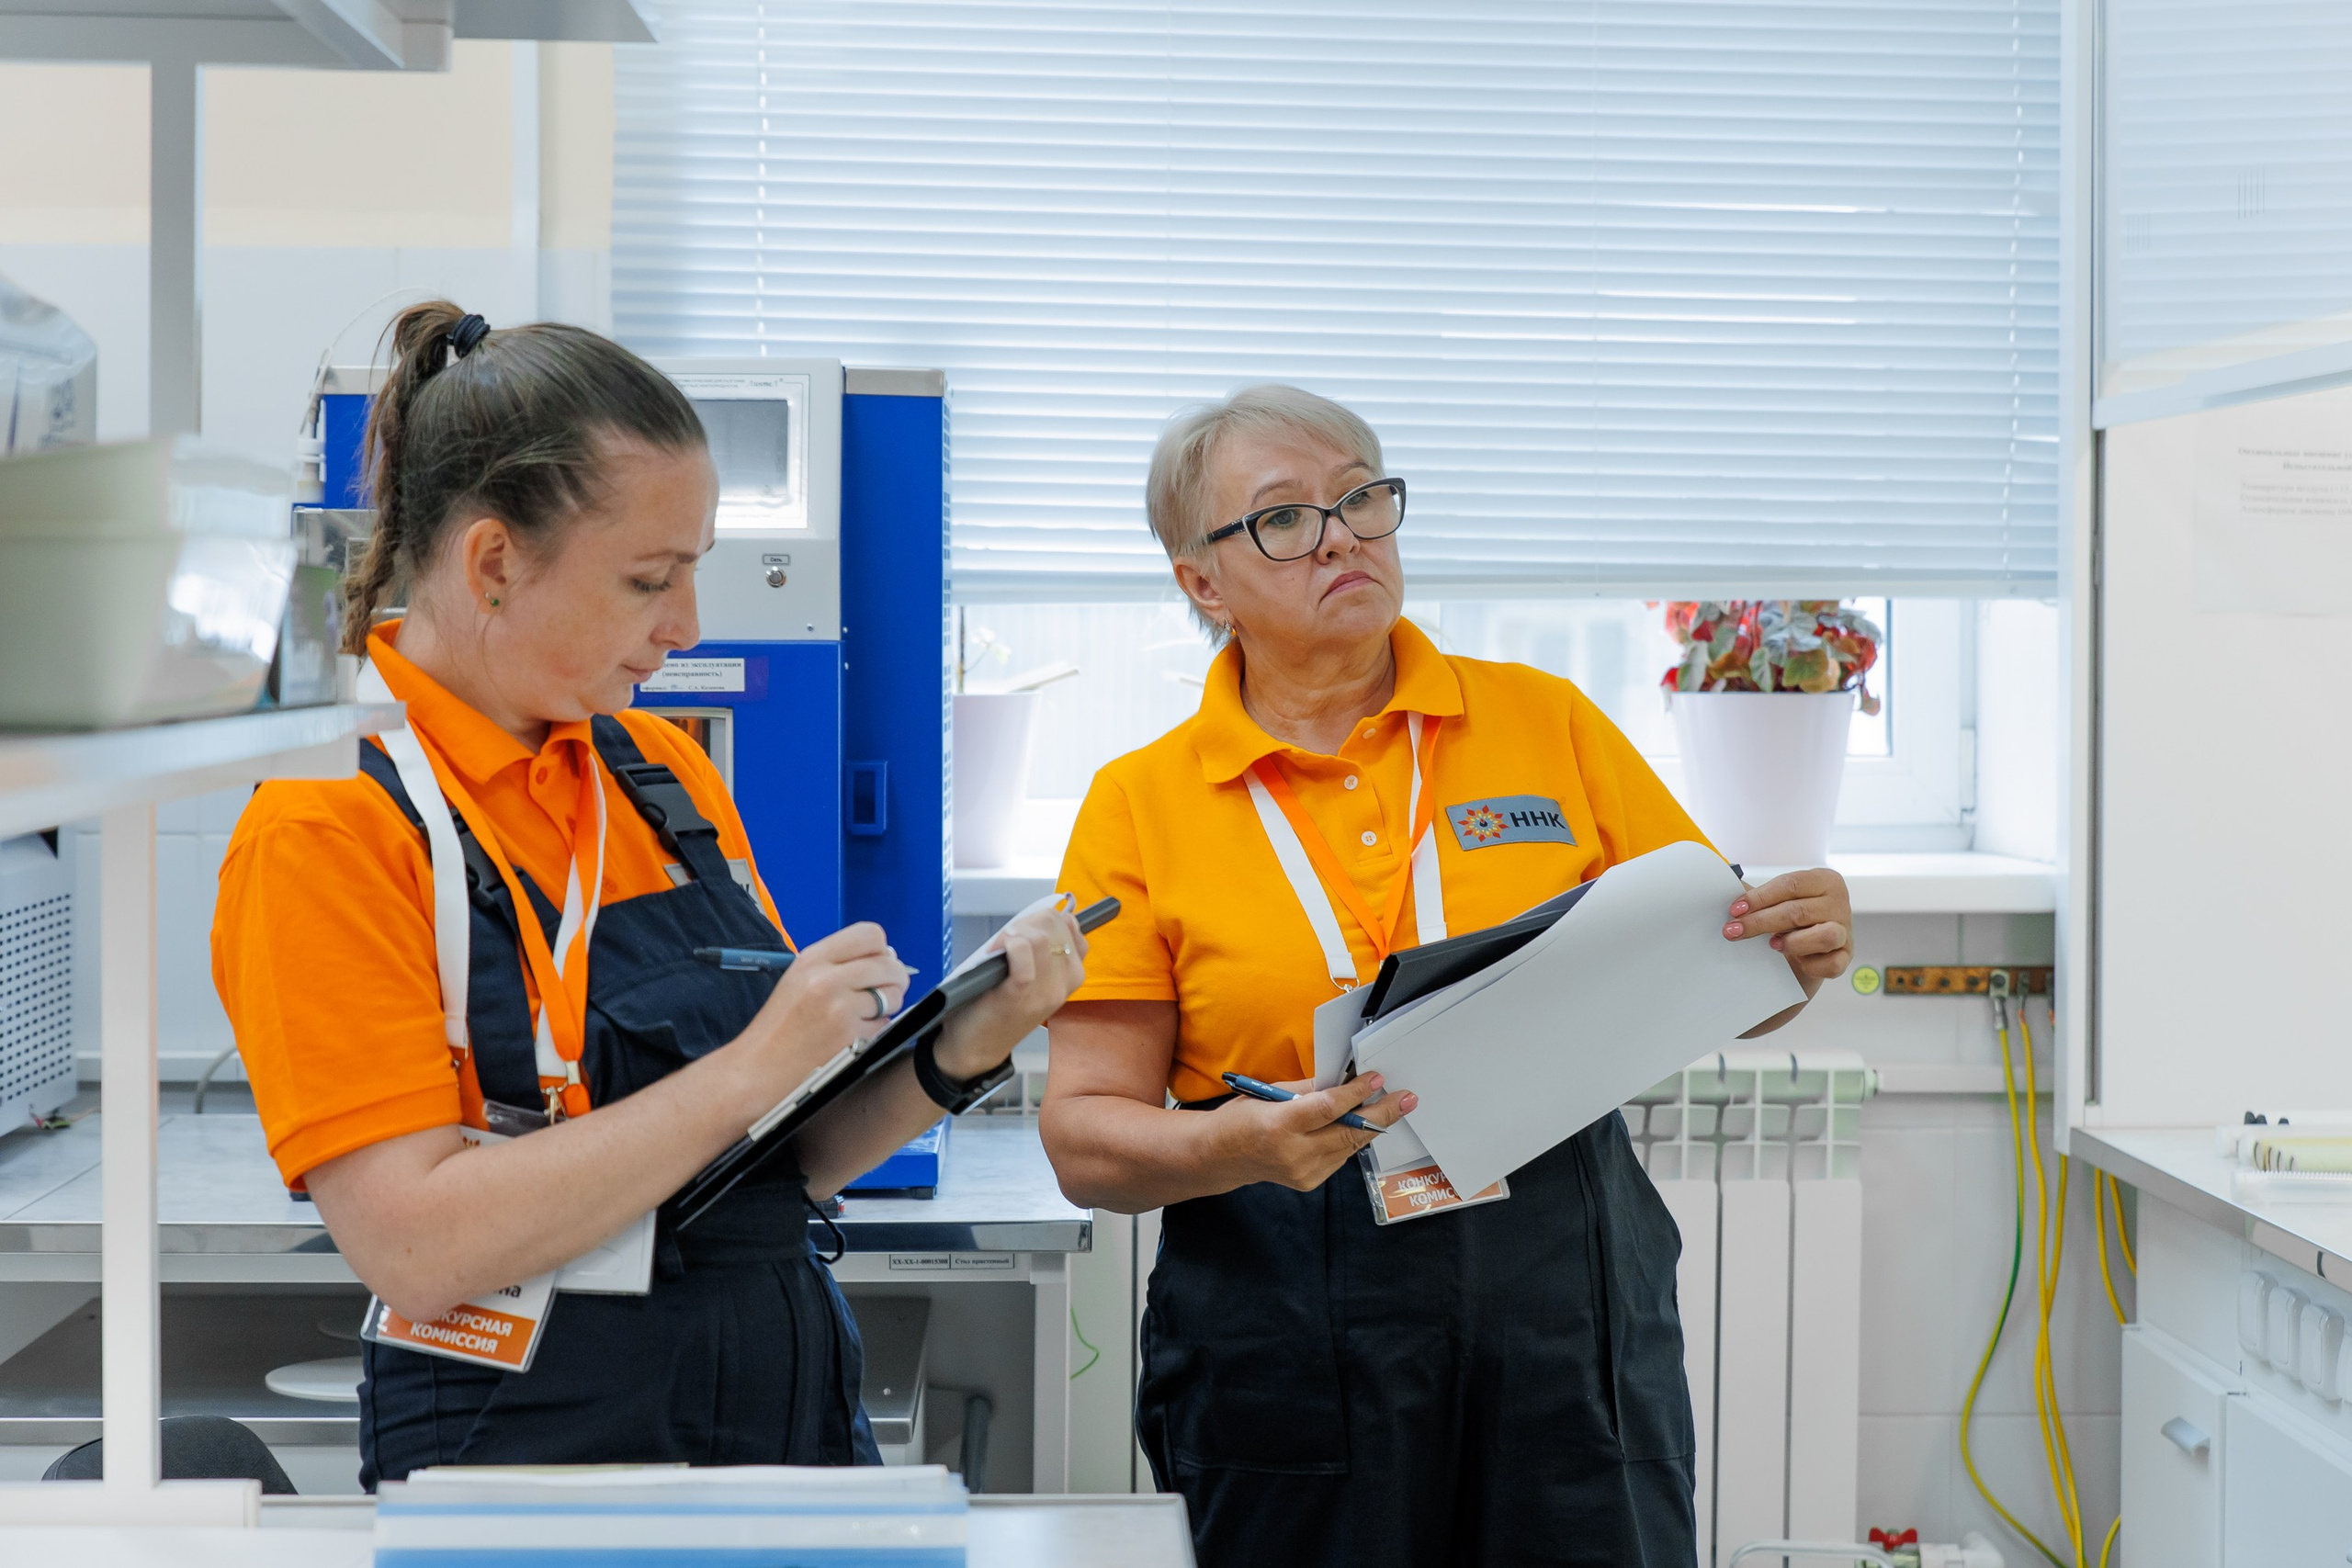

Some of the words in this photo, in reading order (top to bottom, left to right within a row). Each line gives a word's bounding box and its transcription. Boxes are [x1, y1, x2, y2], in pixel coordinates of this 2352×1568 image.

[1510, 810, 1566, 830] ННК
[1397, 1171, 1447, 1192] КОНКУР
[1408, 1187, 1459, 1207] КОМИС
[439, 1308, 514, 1337] КУРСНАЯ
[410, 1322, 499, 1355] КОМИССИЯ
